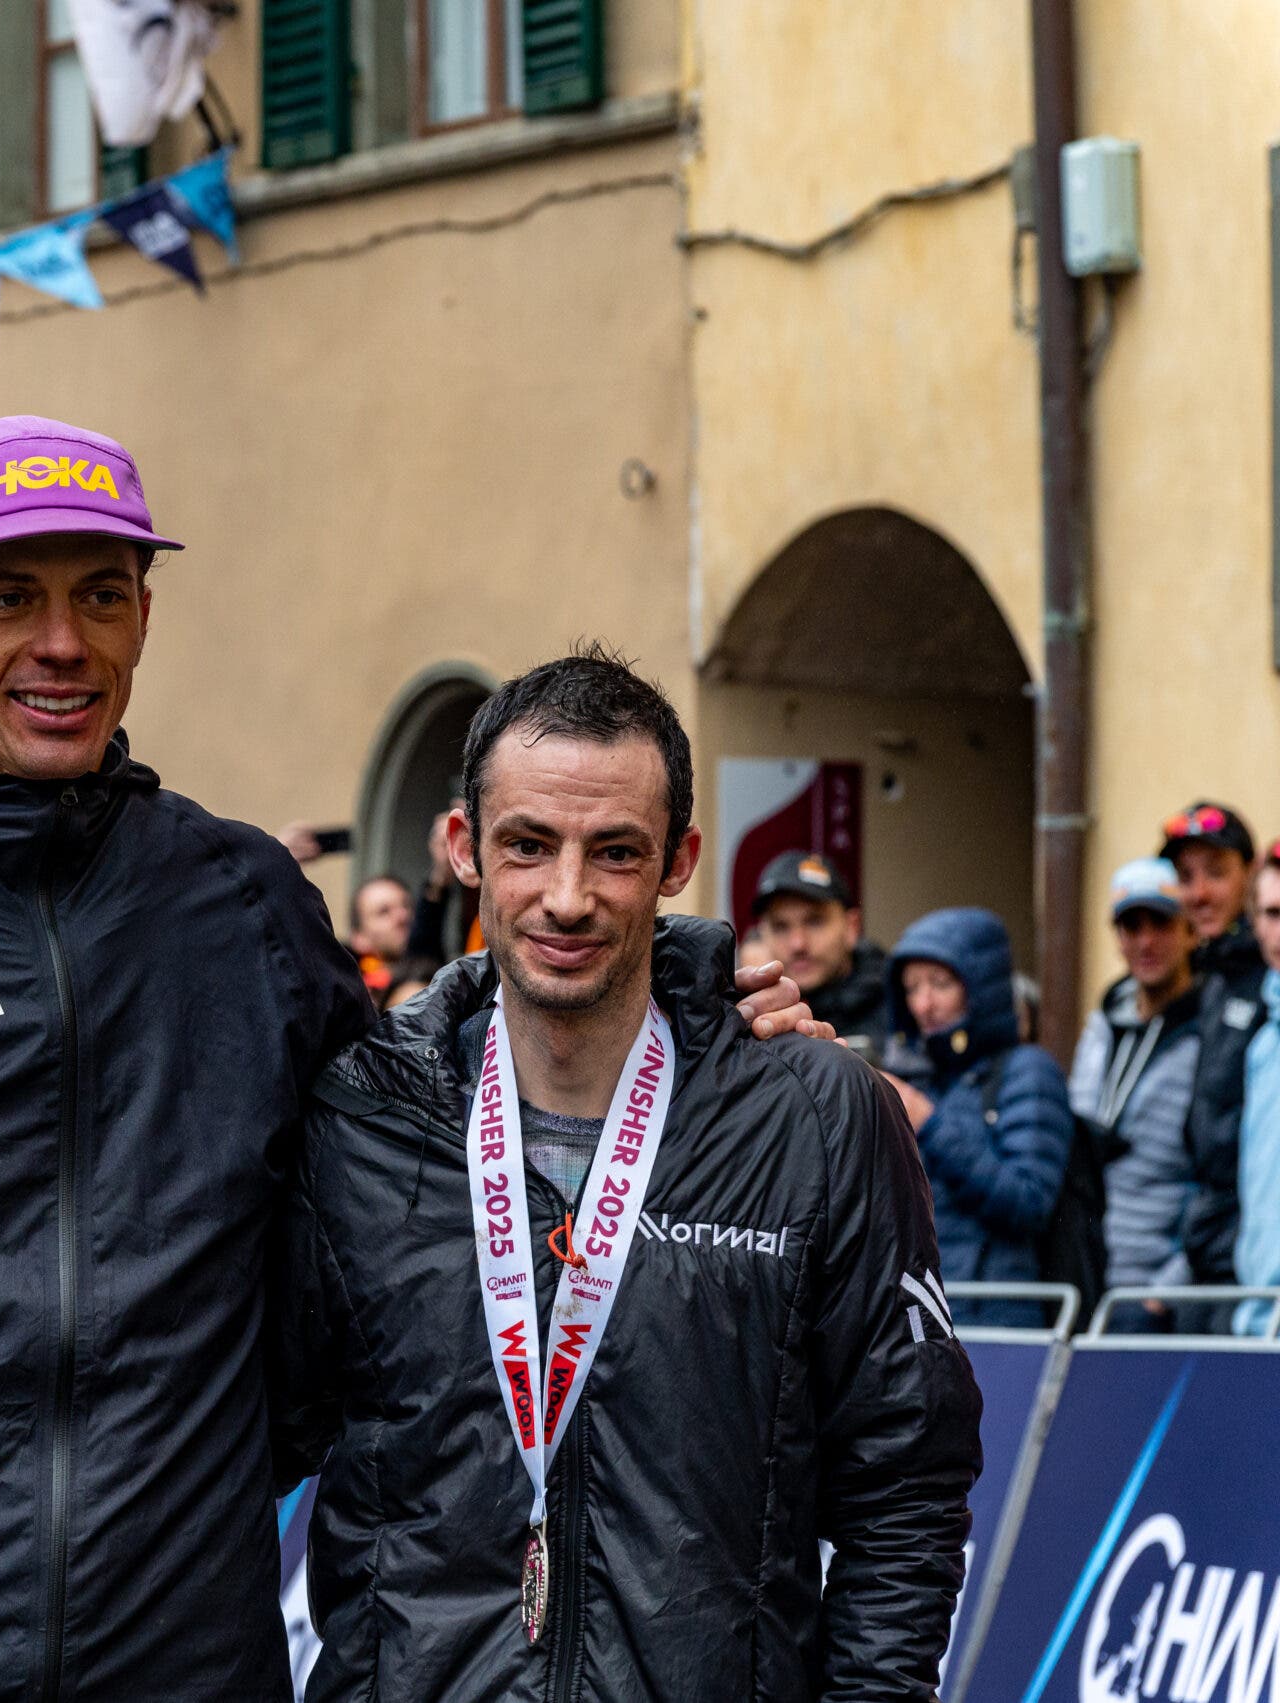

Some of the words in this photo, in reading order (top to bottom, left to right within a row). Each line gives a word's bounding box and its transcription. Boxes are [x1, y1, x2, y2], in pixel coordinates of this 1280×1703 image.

[610, 1030, 666, 1166] FINISHER
[483, 1173, 515, 1258] 2025
[585, 1173, 631, 1258] 2025
[486, 1272, 527, 1291] CHIANTI
[568, 1269, 613, 1291] CHIANTI
